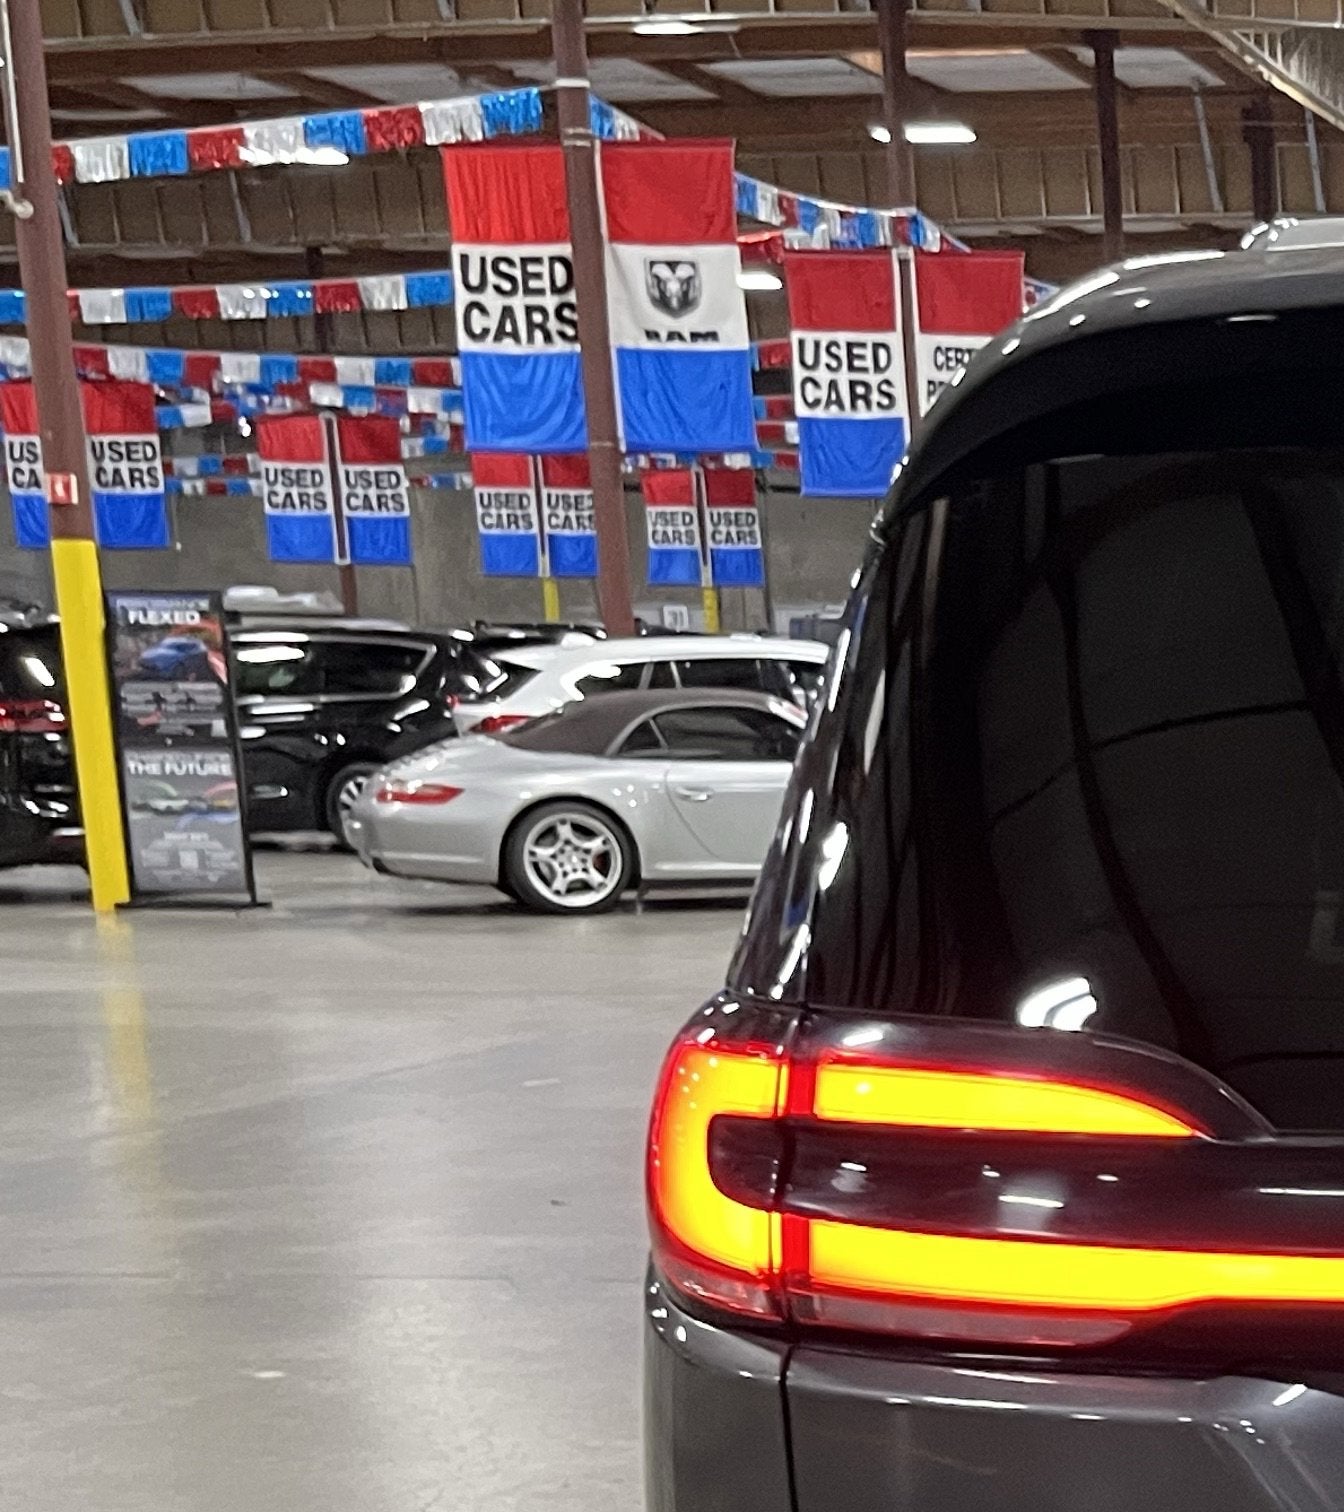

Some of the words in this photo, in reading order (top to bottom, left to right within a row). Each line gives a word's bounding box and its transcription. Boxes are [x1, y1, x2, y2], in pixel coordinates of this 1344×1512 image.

[460, 253, 574, 297] USED
[463, 301, 578, 344] CARS
[798, 338, 892, 374] USED
[801, 376, 896, 412] CARS
[9, 441, 39, 464] US
[91, 441, 157, 463] USED
[12, 467, 41, 489] CA
[96, 466, 160, 488] CARS
[265, 468, 324, 488] USED
[344, 470, 401, 490] USED
[267, 491, 327, 510] CARS
[346, 493, 405, 512] CARS
[479, 493, 531, 510] USED
[480, 512, 533, 530] CARS
[649, 511, 694, 527] USED
[710, 511, 756, 527] USED
[652, 530, 695, 545] CARS
[711, 530, 758, 545] CARS
[128, 760, 161, 775] THE
[165, 761, 232, 776] FUTURE
